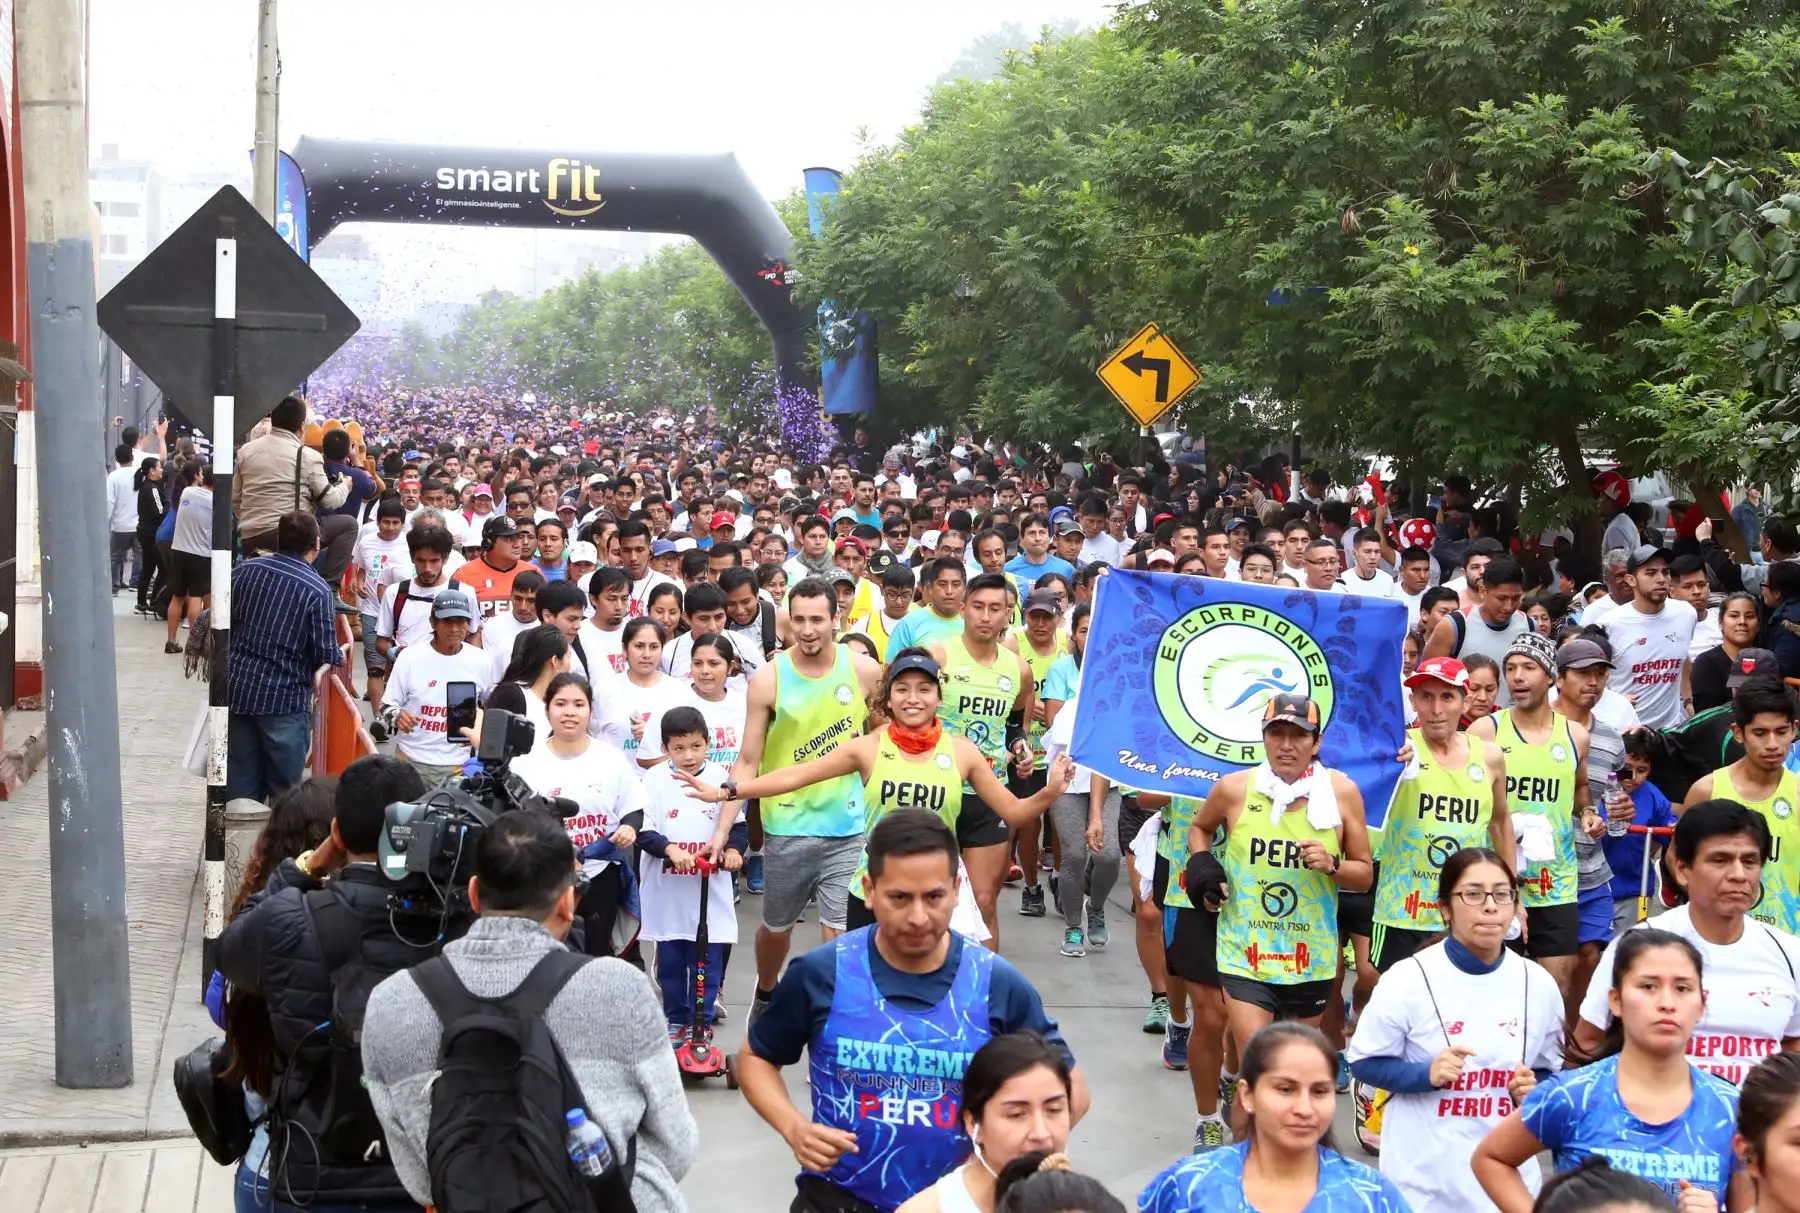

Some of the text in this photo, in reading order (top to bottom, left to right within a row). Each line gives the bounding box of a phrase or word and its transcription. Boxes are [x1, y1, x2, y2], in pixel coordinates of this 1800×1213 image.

[436, 158, 602, 201] smart fit
[1160, 606, 1329, 688] ESCORPIONES
[1631, 658, 1682, 673] DEPORTE
[958, 695, 1007, 717] PERU
[793, 716, 853, 762] ESCORPIONES
[1118, 749, 1160, 774] Una
[880, 779, 946, 812] PERU
[1505, 775, 1560, 803] PERU
[1418, 793, 1480, 824] PERU
[1248, 920, 1311, 932] MANTRA FISIO
[696, 960, 706, 1005] SCOOTER
[859, 1093, 957, 1129] PERÚ
[1437, 1093, 1493, 1118] PERÚ
